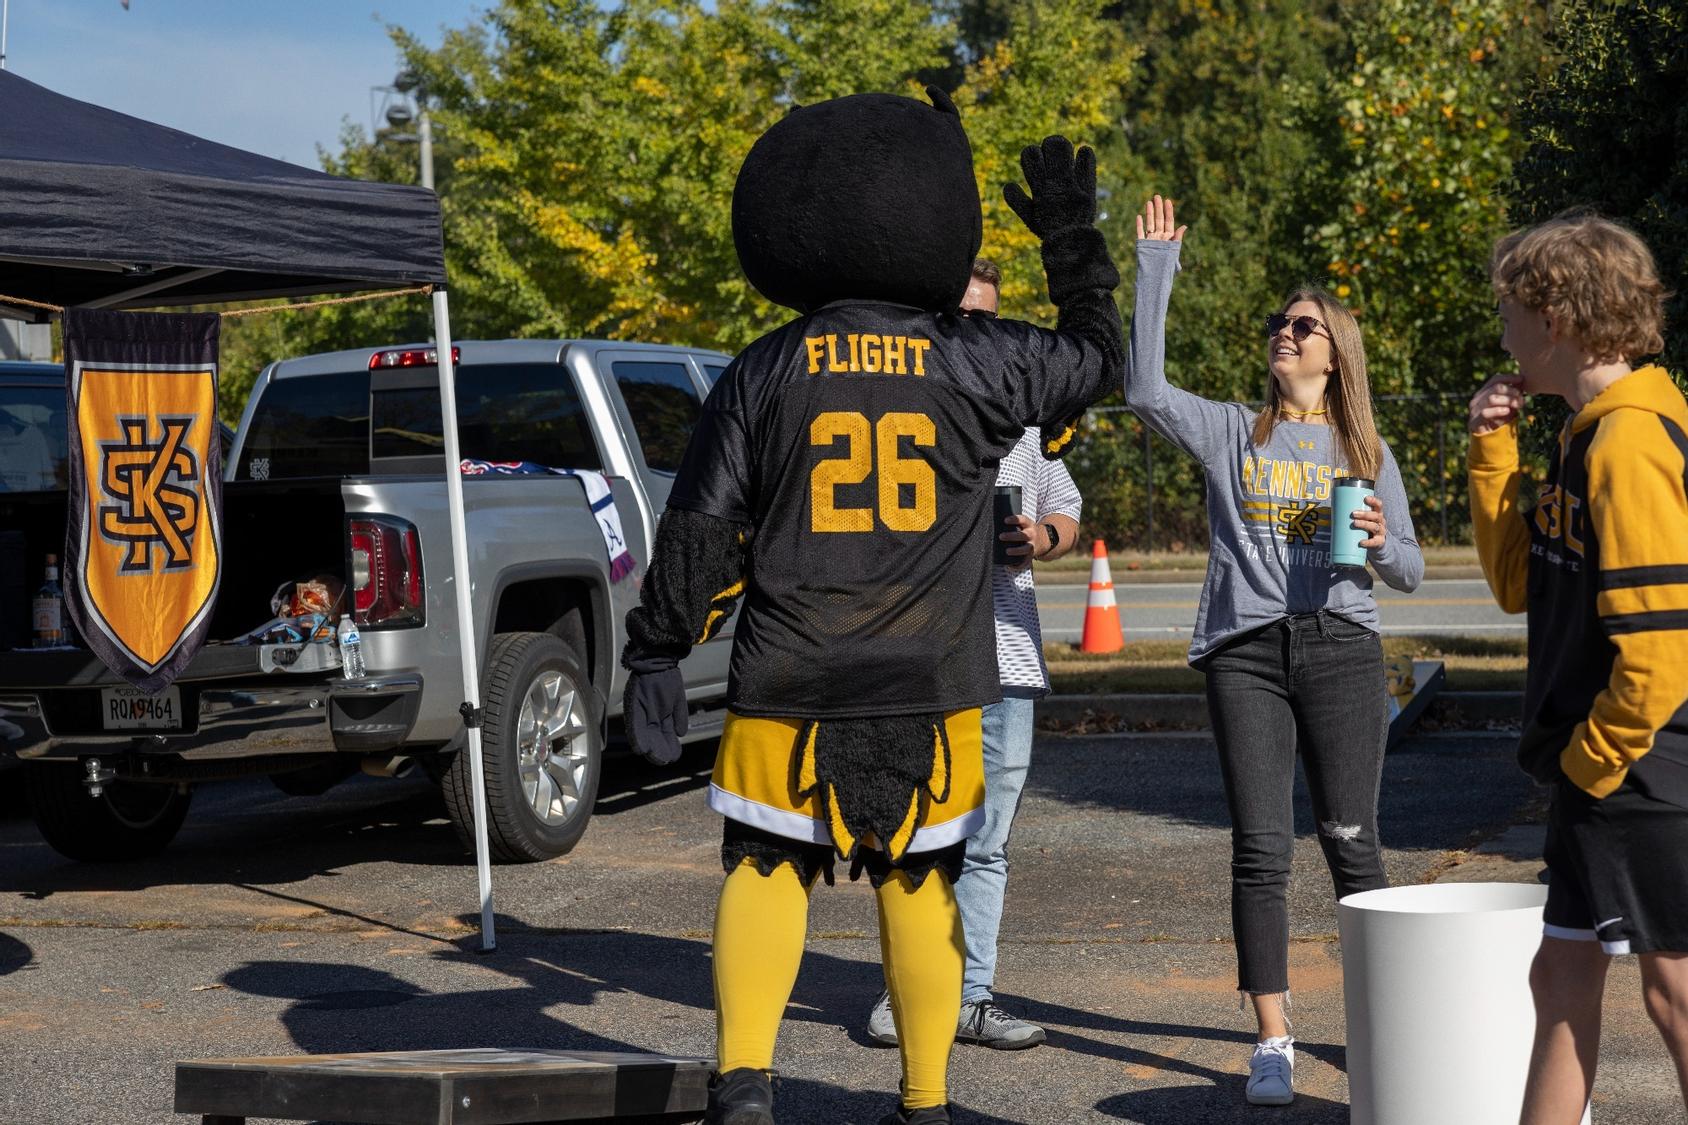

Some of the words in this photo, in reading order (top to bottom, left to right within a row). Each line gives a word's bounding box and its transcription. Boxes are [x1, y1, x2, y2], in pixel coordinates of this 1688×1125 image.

[805, 333, 931, 377] FLIGHT
[810, 411, 937, 533] 26
[1278, 546, 1333, 569] UNIVERS
